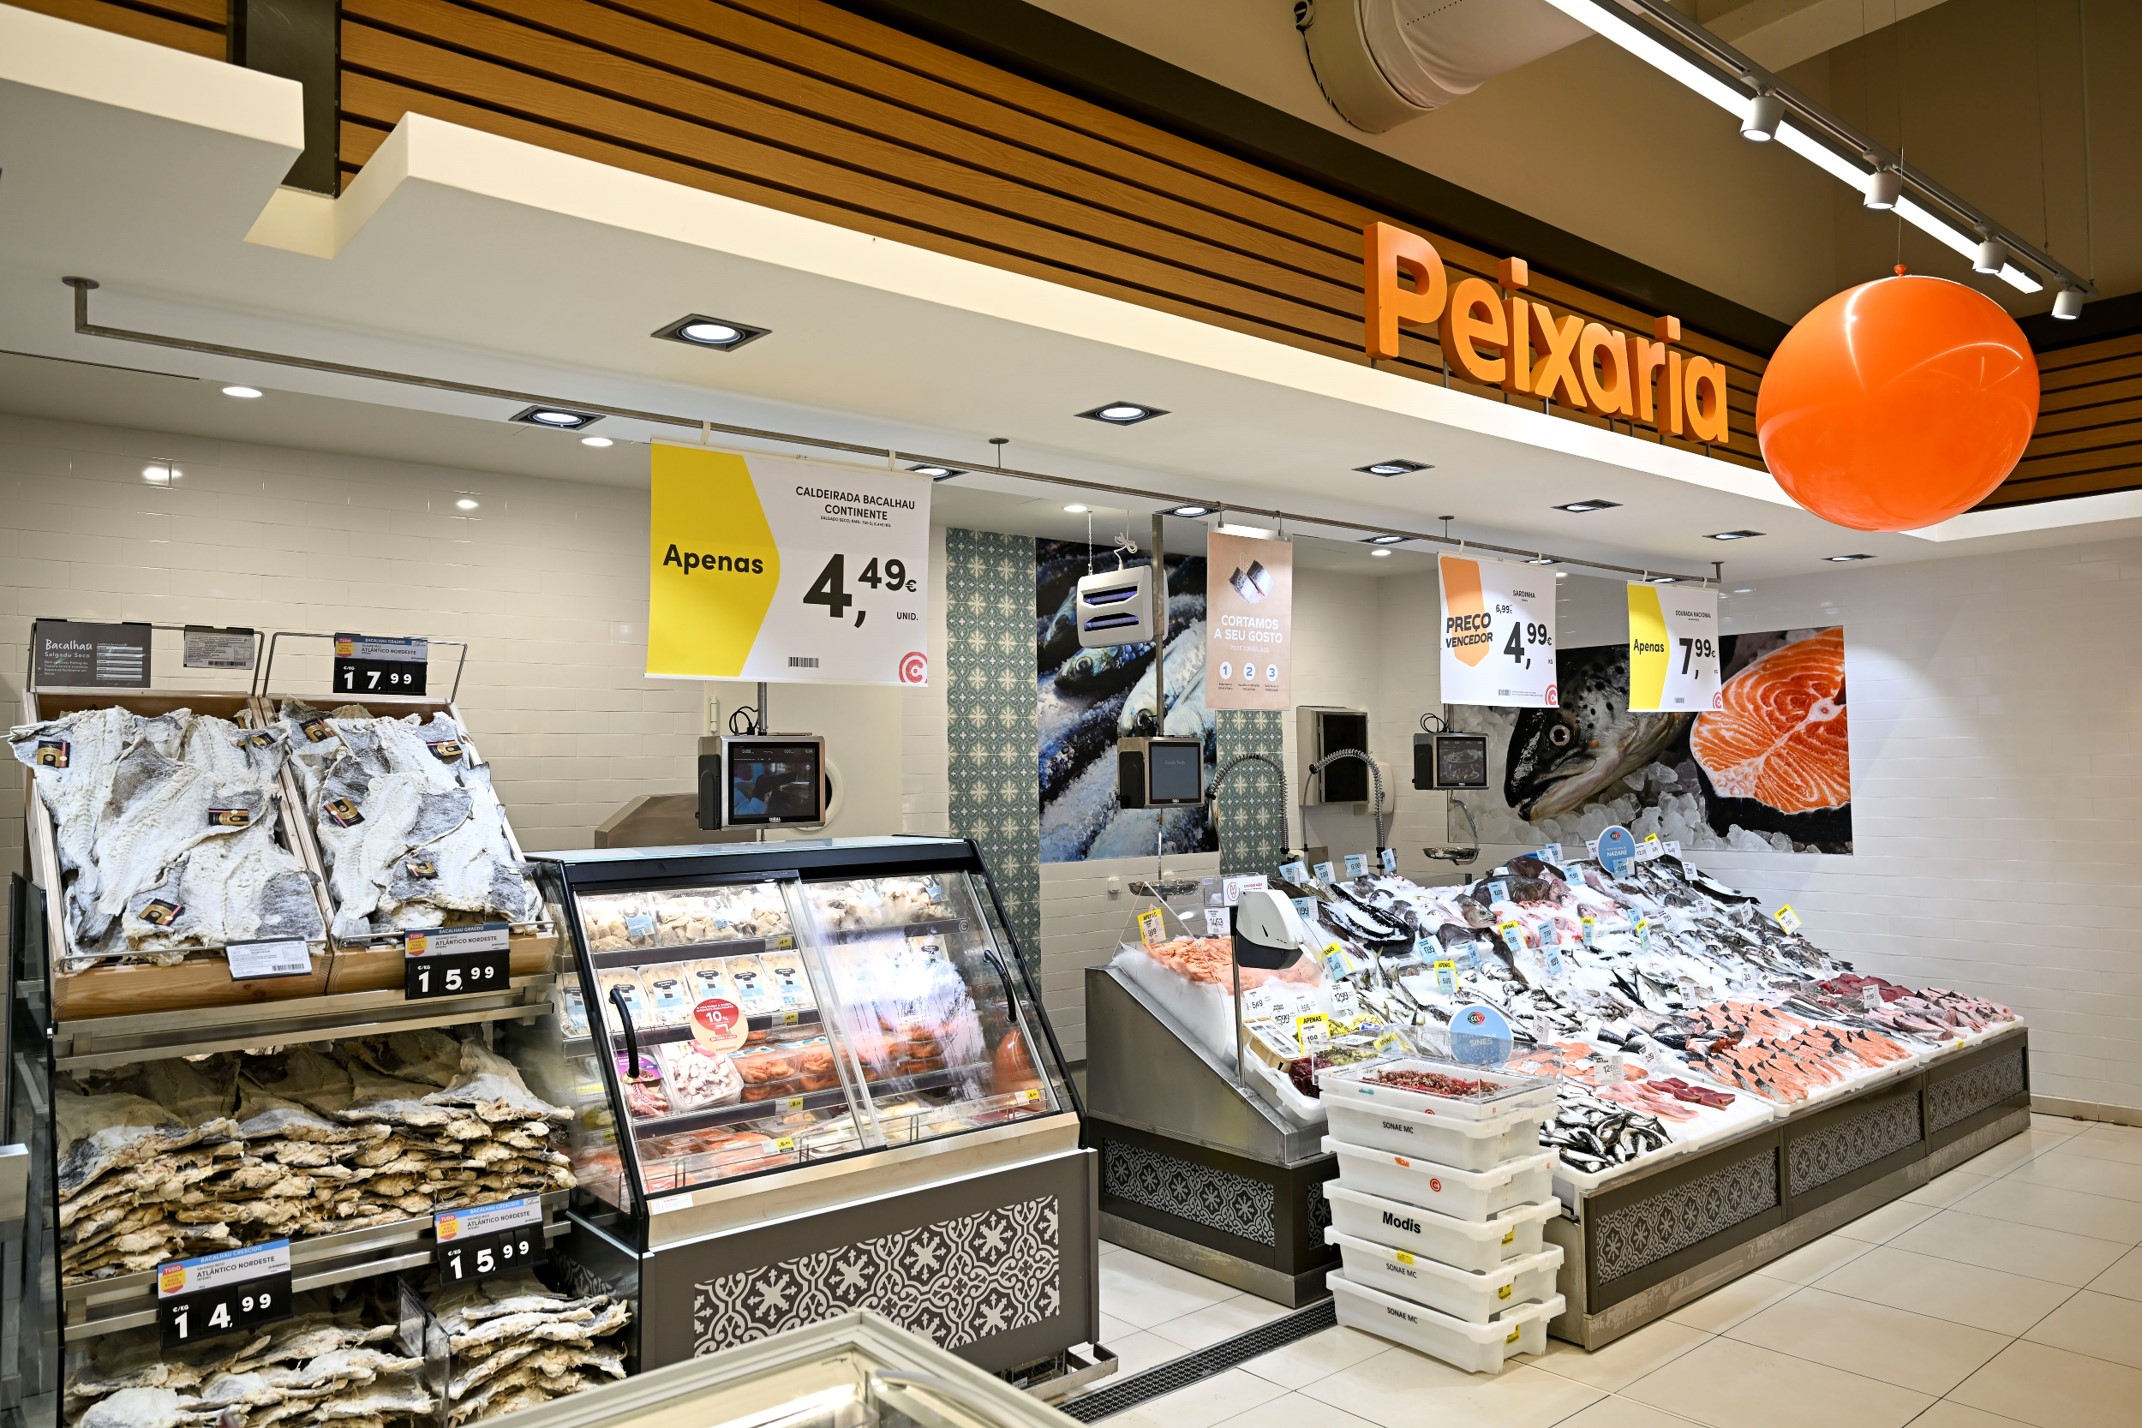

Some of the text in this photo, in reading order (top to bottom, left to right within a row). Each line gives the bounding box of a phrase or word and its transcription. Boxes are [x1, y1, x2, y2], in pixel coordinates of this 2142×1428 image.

[1363, 221, 1729, 444] Peixaria
[795, 486, 915, 510] CALDEIRADA BACALHAU
[824, 504, 888, 521] CONTINENTE
[662, 543, 764, 575] Apenas
[1512, 589, 1536, 599] SARDINHA
[896, 611, 919, 621] UNID.
[1221, 614, 1279, 630] CORTAMOS
[1446, 612, 1492, 634] PREÇO
[1213, 628, 1283, 643] A SEU GOSTO
[1445, 632, 1493, 649] VENCEDOR
[45, 638, 93, 651] Bacalhau
[361, 646, 389, 654] ATLÂNTICO
[1633, 638, 1665, 655] Apenas
[44, 651, 72, 659] Salgado
[1222, 665, 1276, 678] 1 2 3
[435, 935, 497, 946] ATLÂNTICO NORDESTE
[705, 1010, 729, 1023] 10%
[1303, 1015, 1322, 1024] APENAS
[1469, 1037, 1493, 1047] SINES
[1382, 1121, 1414, 1134] SONAE MC
[469, 1205, 495, 1214] BACALHAU
[495, 1201, 520, 1210] CRESCIDO
[467, 1217, 500, 1227] ATLÂNTICO
[500, 1211, 530, 1221] NORDESTE
[1382, 1211, 1421, 1234] Modis
[200, 1245, 263, 1263] BACALHAU CRESCIDO
[165, 1265, 181, 1273] TUDO
[196, 1264, 237, 1278] ATLÂNTICO
[238, 1256, 275, 1268] NORDESTE
[1385, 1262, 1417, 1279] SONAE MC
[1386, 1306, 1418, 1324] SONAE MC
